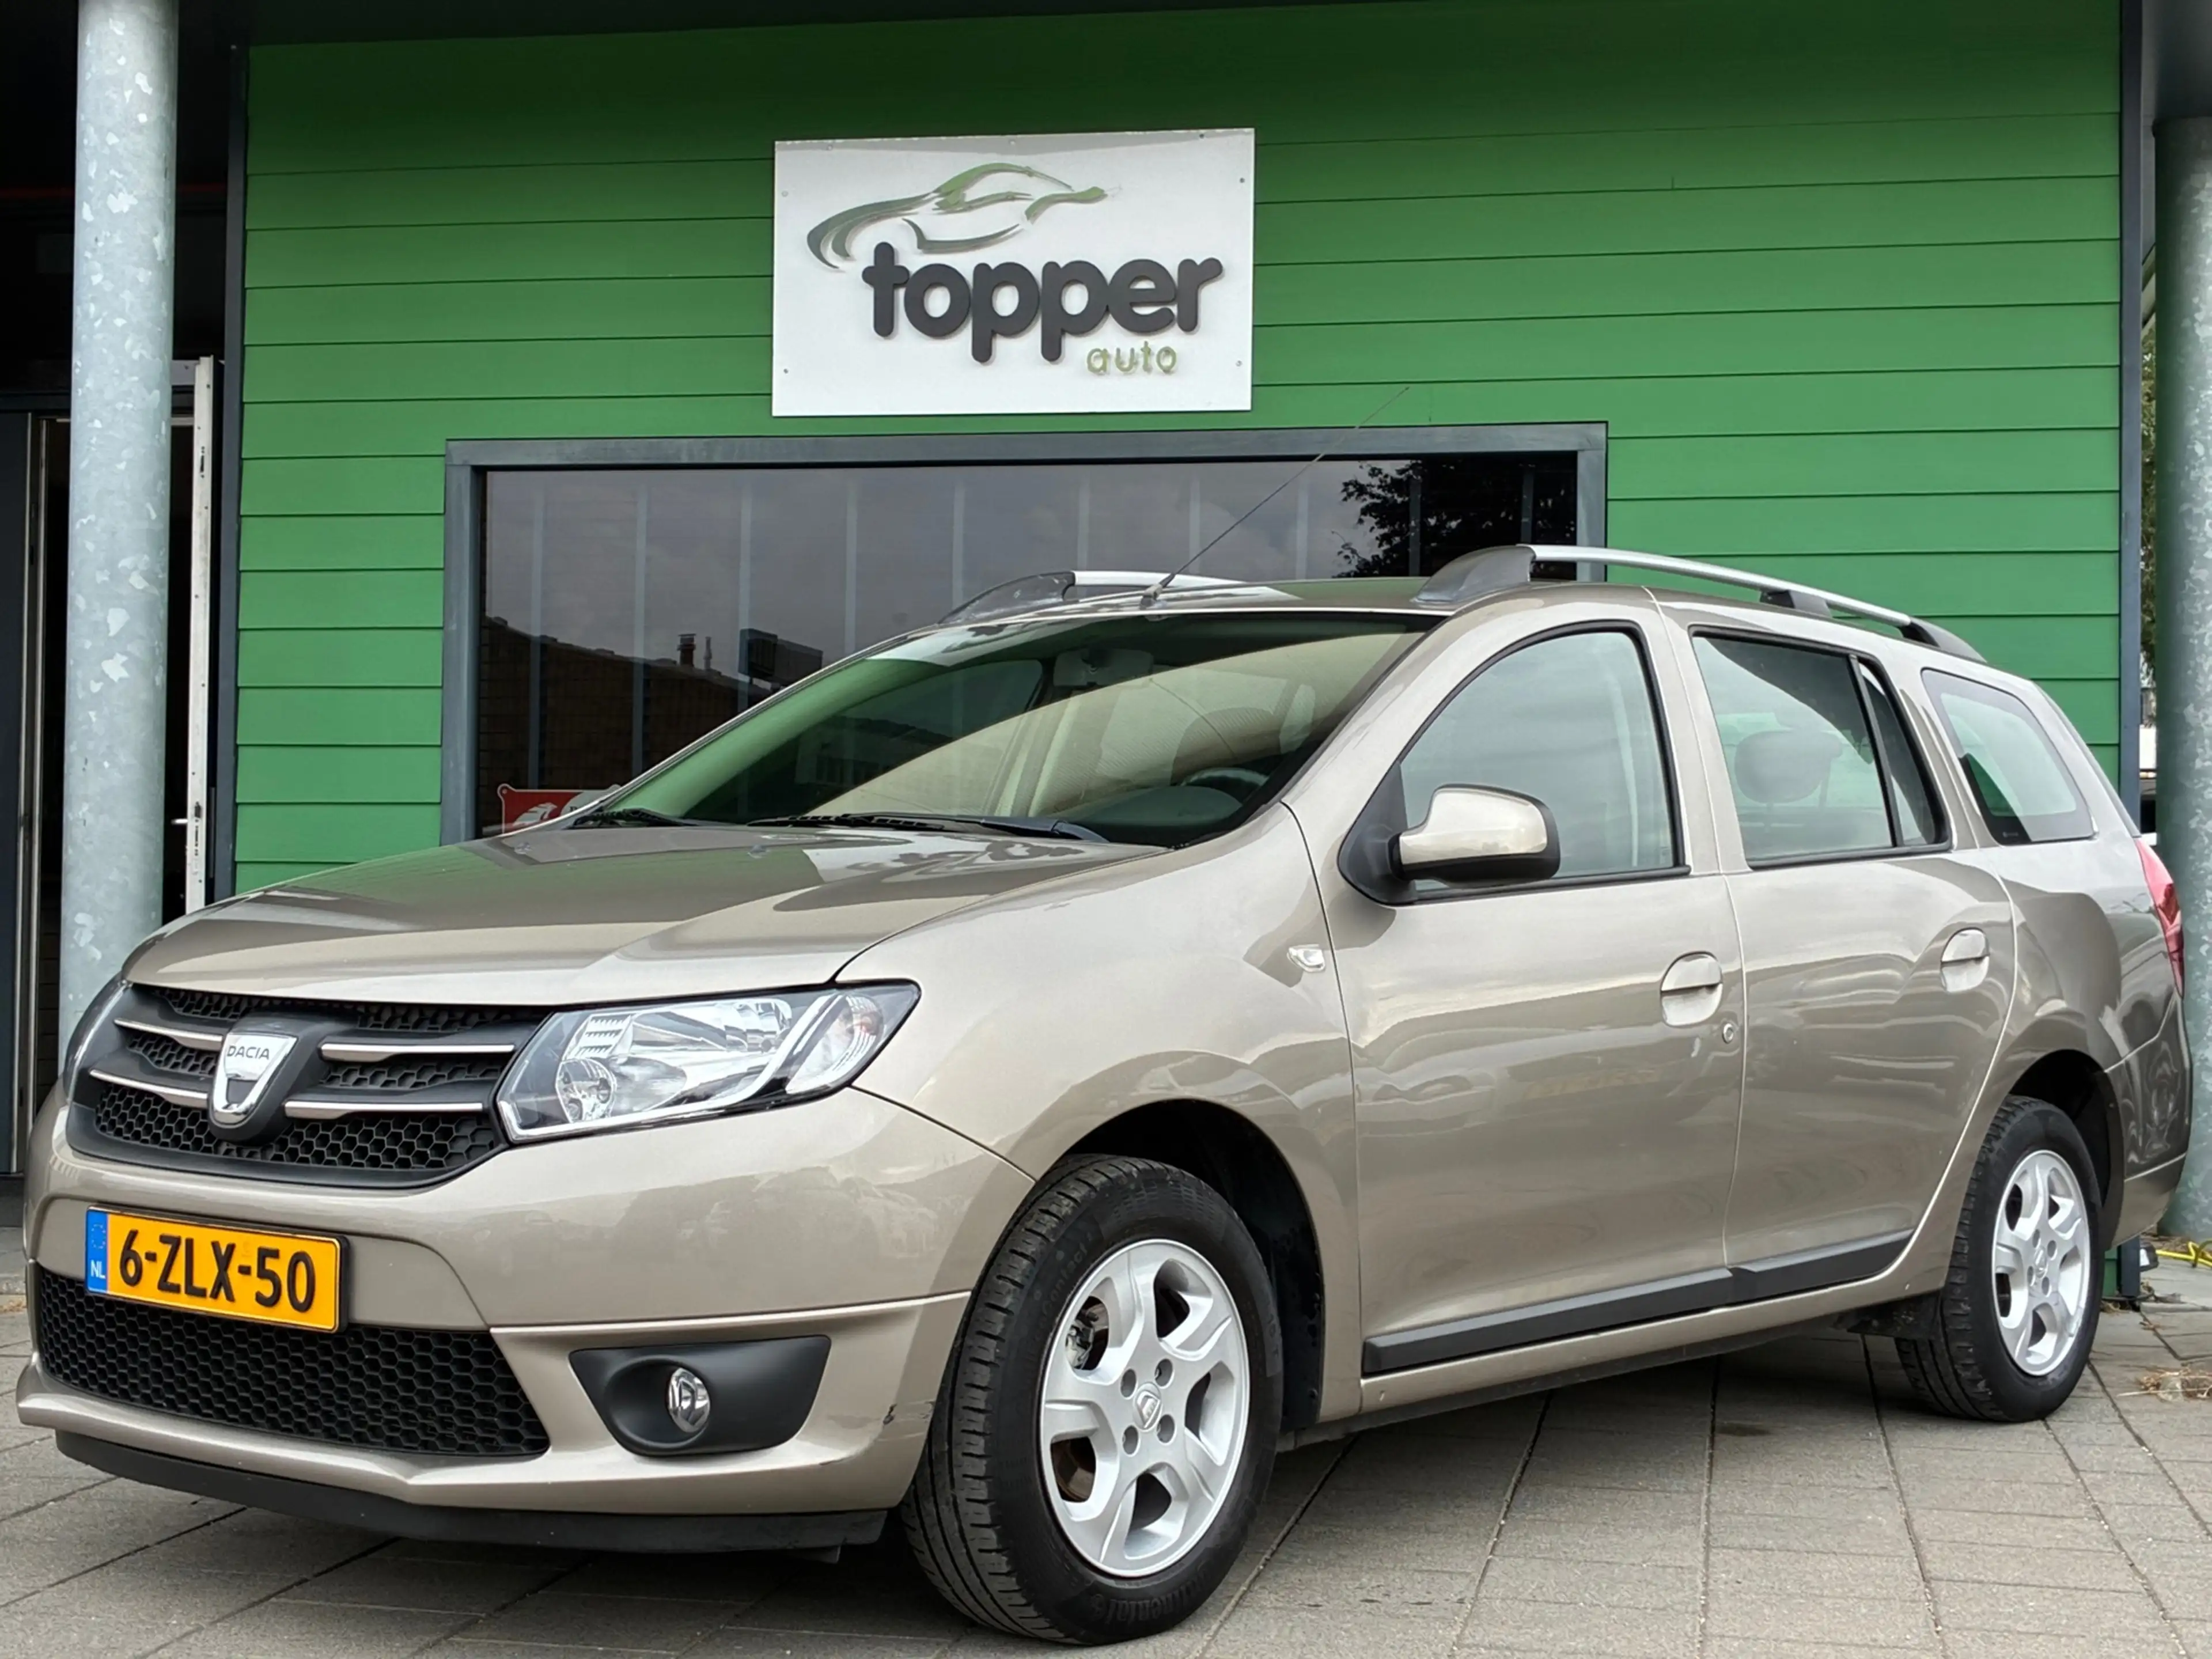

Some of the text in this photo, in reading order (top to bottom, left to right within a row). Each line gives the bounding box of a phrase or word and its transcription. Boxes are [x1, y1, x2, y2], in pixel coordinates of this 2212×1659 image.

[862, 241, 1223, 363] topper
[1086, 341, 1178, 373] auto
[227, 1045, 269, 1060] DACIA
[90, 1260, 105, 1279] NL
[119, 1229, 315, 1313] 6-ZLX-50
